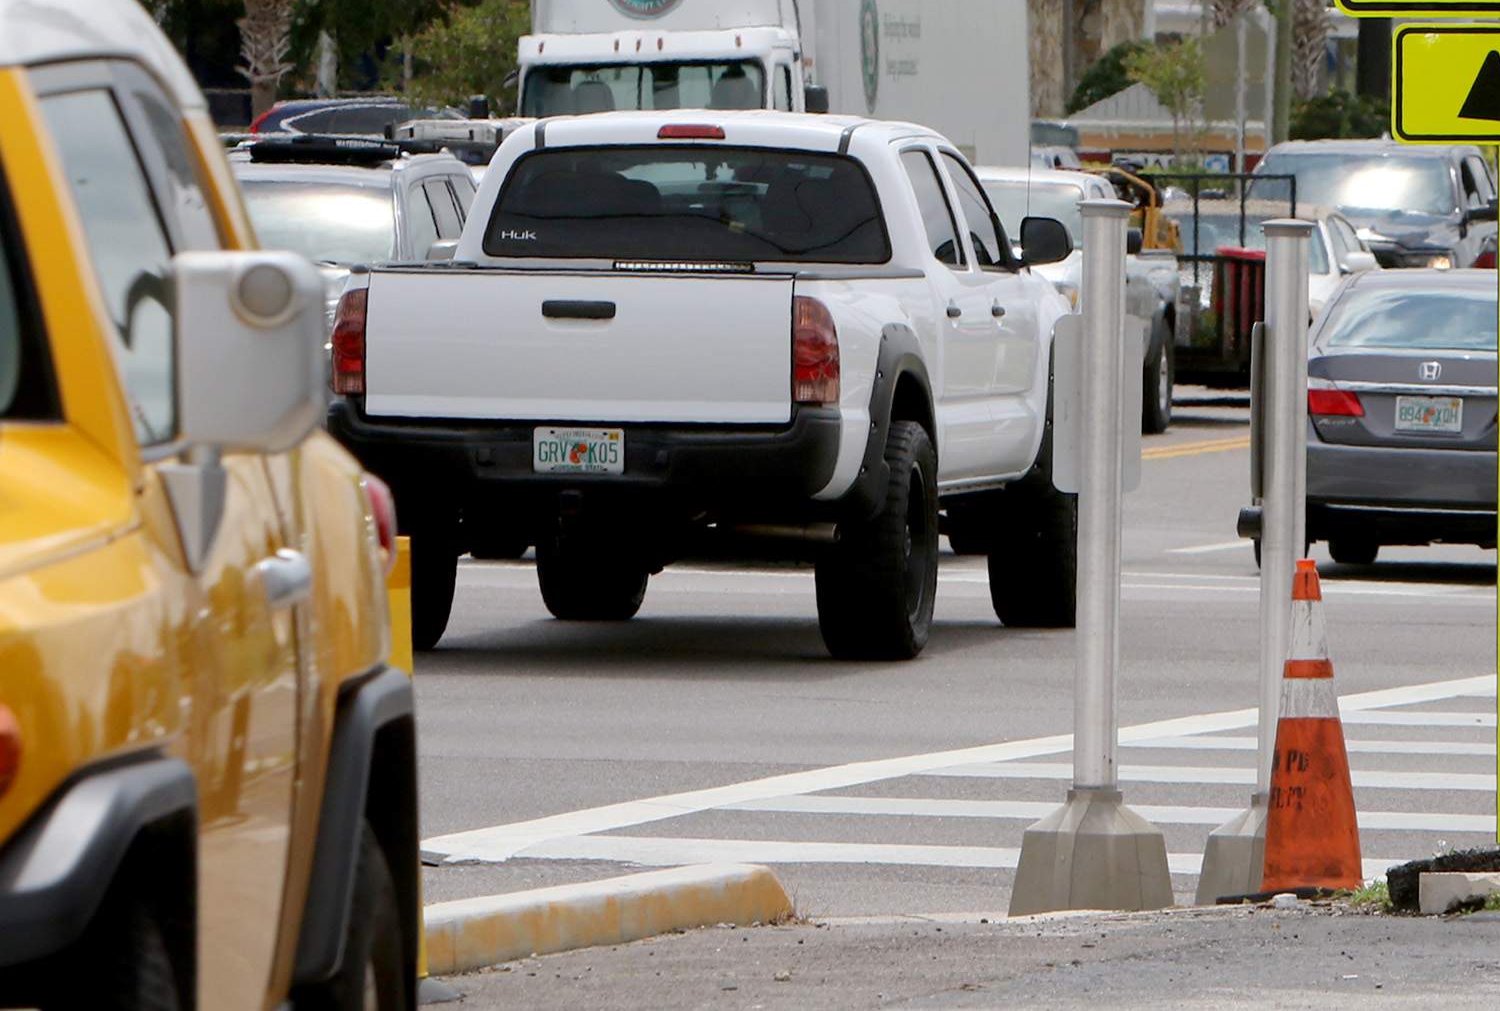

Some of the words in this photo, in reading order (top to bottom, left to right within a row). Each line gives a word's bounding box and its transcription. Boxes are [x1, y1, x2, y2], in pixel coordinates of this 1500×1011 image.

[501, 229, 537, 240] Huk
[538, 440, 568, 462] GRV
[588, 442, 619, 464] K05
